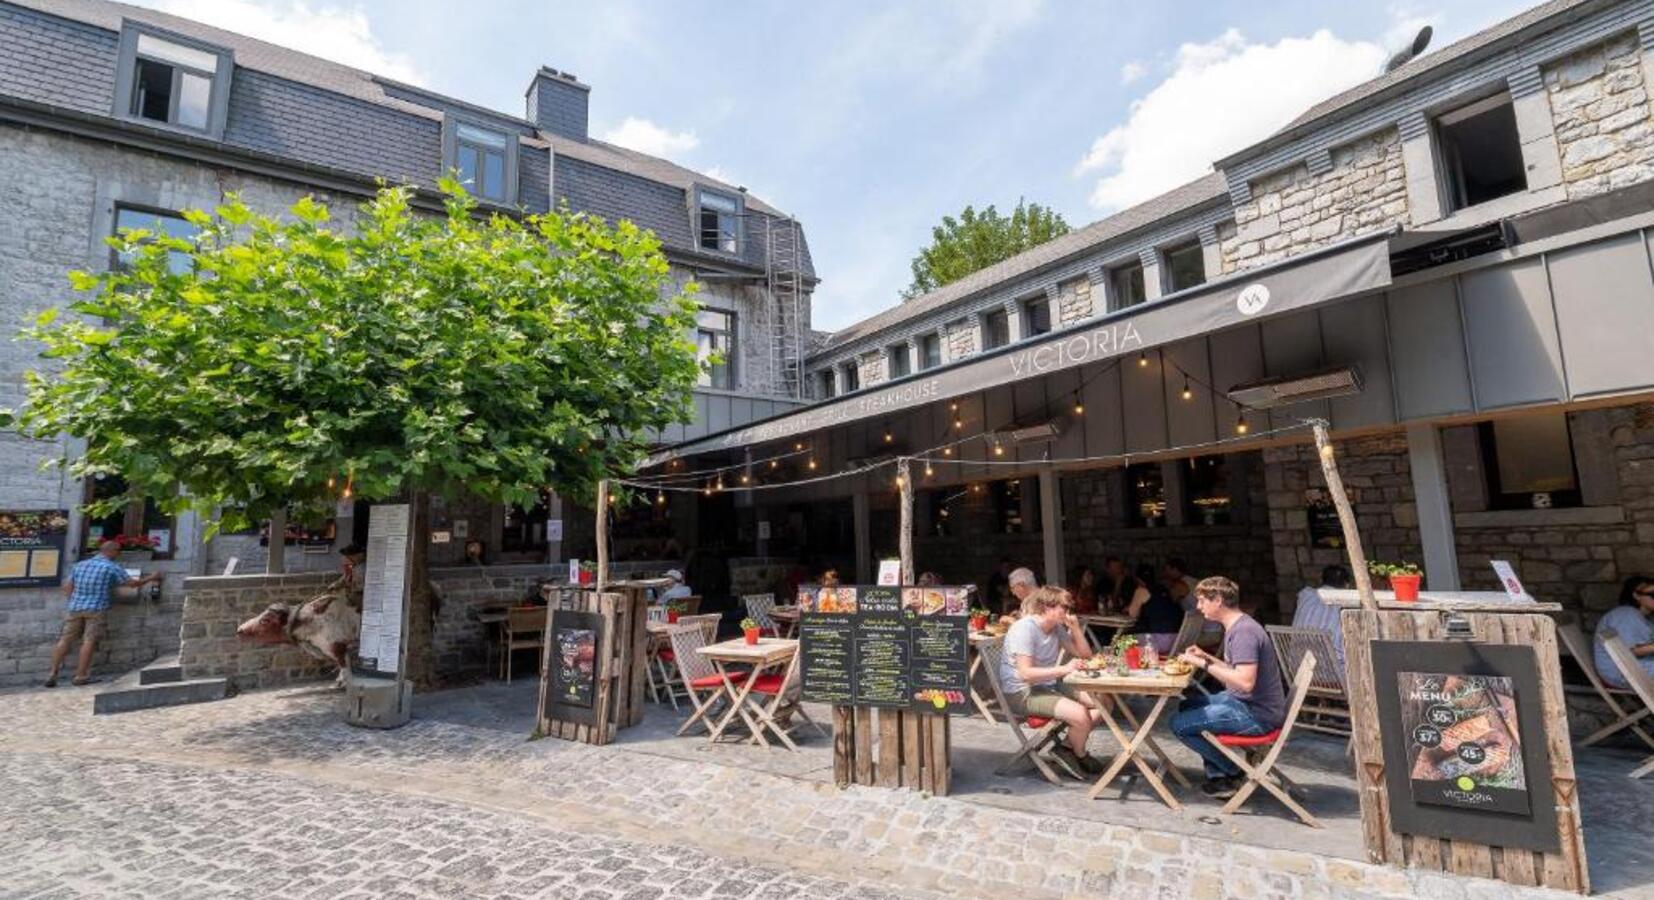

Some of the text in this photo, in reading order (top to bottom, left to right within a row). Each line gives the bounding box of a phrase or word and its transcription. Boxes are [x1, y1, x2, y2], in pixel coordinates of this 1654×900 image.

[1009, 322, 1143, 377] VICTORIA
[858, 380, 940, 413] STEAKHOUSE
[1410, 690, 1451, 701] MENU
